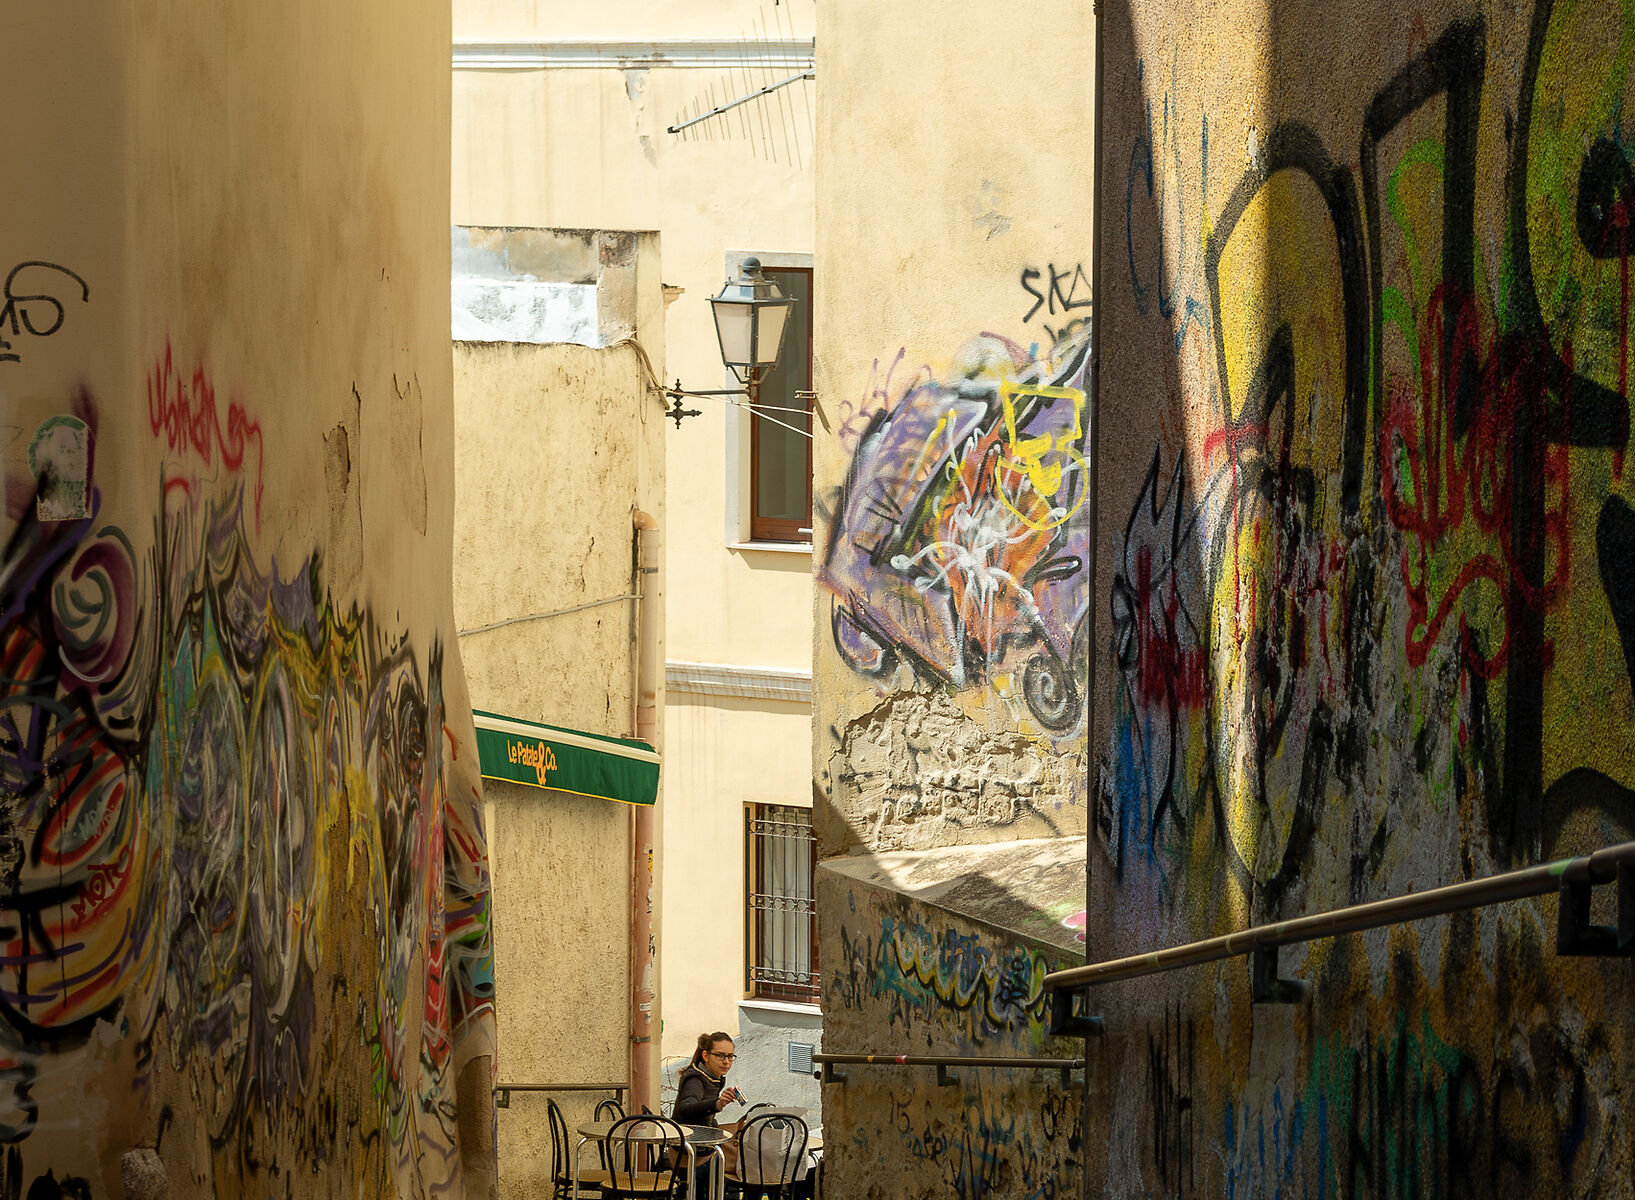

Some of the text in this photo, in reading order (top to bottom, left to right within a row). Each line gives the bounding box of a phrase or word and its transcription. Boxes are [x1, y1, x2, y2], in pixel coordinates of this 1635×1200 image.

[507, 739, 517, 764] Le
[536, 741, 547, 785] &
[545, 746, 558, 771] Co.
